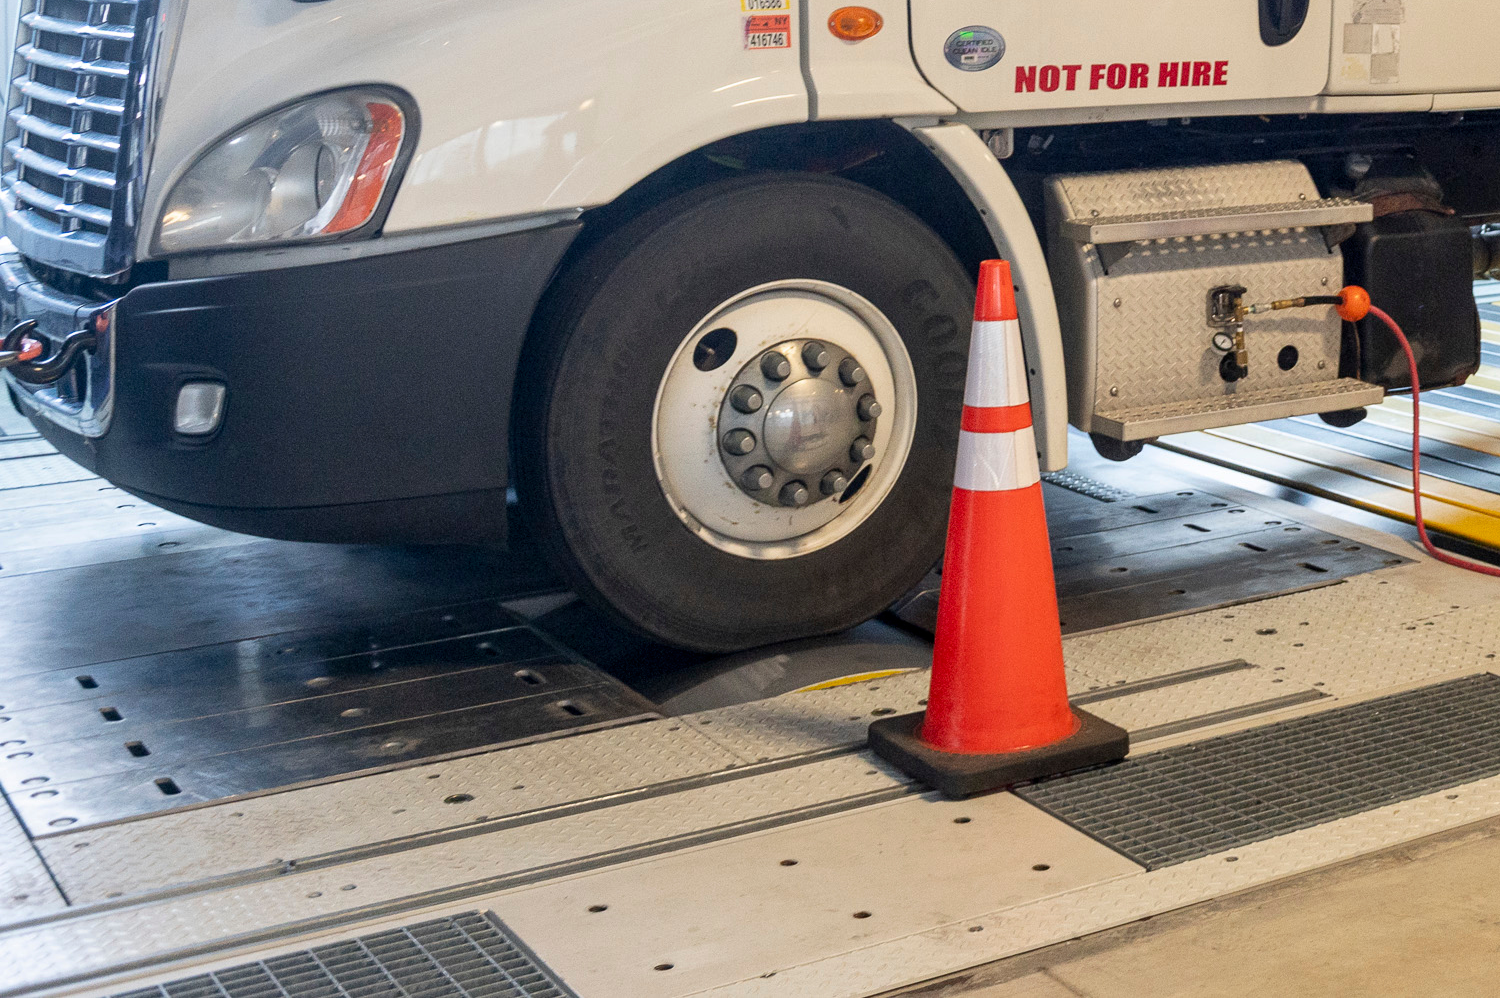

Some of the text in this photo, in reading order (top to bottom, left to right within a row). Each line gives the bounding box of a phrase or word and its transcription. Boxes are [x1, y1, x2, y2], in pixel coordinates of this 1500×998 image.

[956, 39, 993, 47] CERTIFIED
[952, 47, 978, 55] CLEAN
[1014, 60, 1229, 93] NOT FOR HIRE
